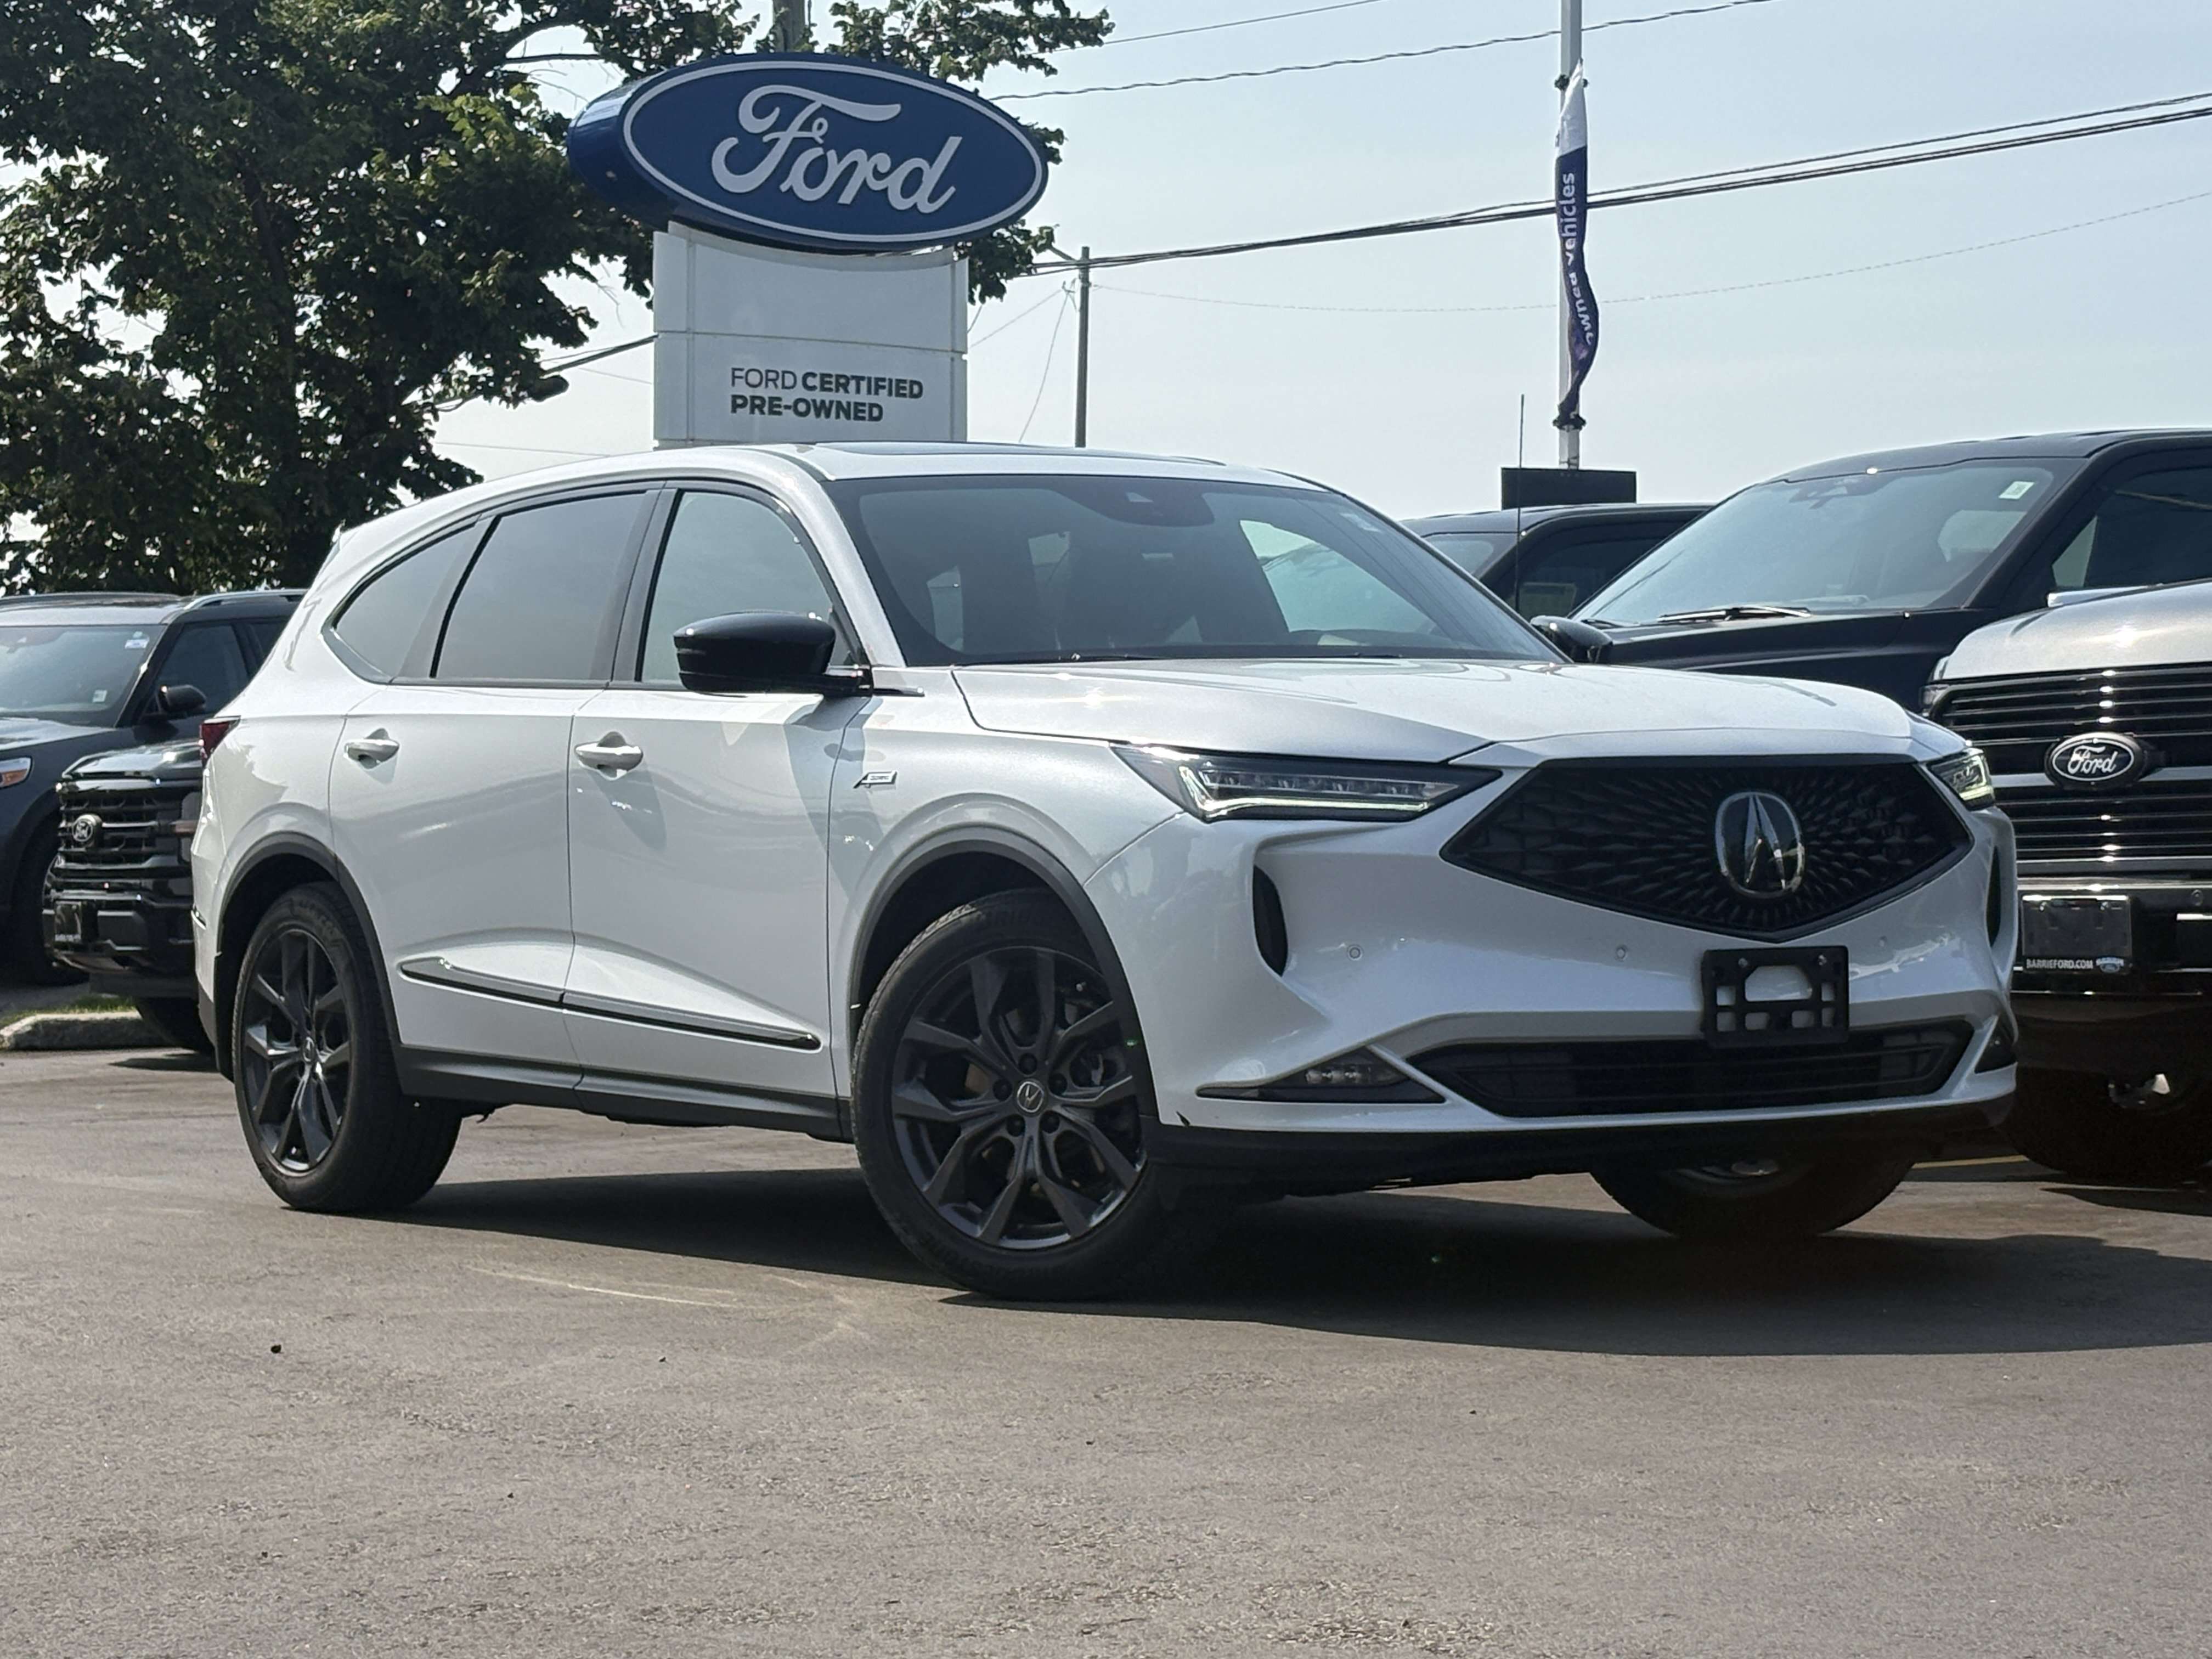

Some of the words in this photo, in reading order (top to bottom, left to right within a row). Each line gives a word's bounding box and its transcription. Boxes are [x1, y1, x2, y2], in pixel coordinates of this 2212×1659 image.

[711, 84, 963, 214] Ford
[1559, 172, 1577, 266] vehicles
[731, 367, 798, 390] FORD
[801, 371, 924, 399] CERTIFIED
[730, 394, 884, 422] PRE-OWNED
[2067, 745, 2118, 775] Ford
[2026, 958, 2094, 969] BARRIEFORD.COM
